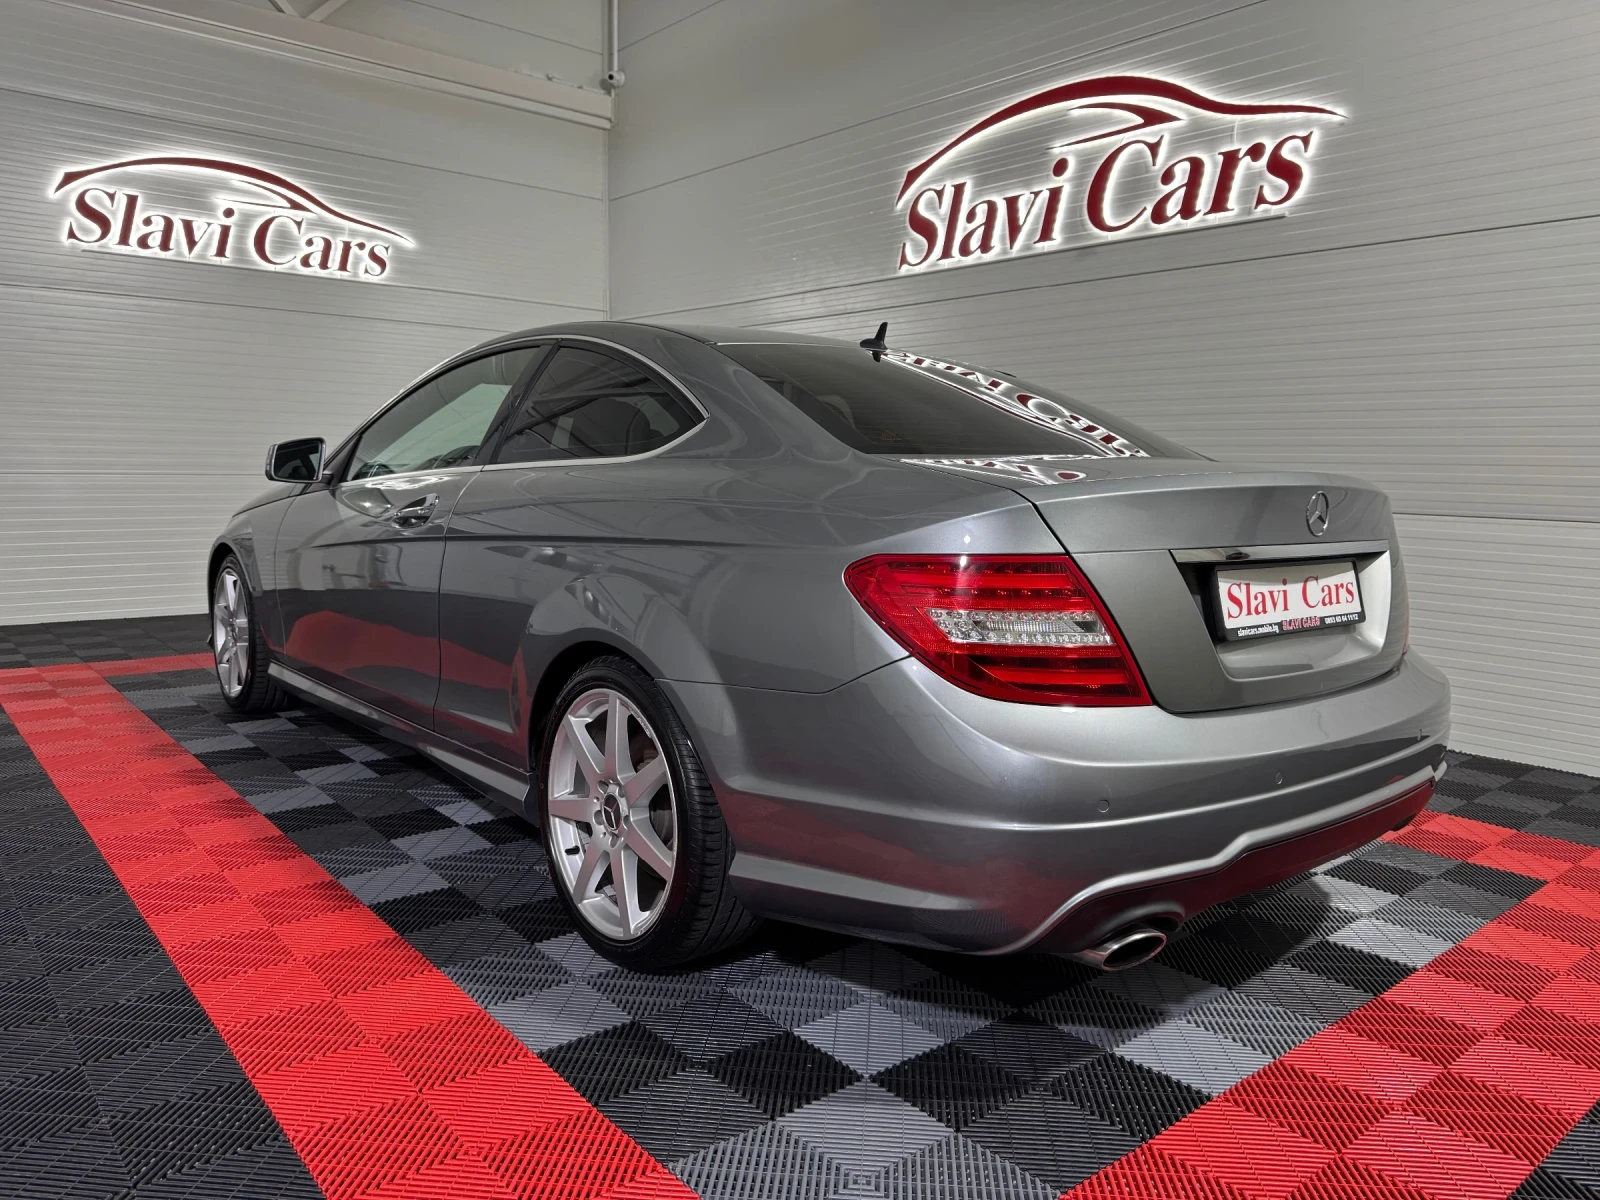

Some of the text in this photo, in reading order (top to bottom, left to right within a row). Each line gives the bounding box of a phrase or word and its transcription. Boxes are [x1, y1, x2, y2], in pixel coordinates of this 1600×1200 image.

[898, 130, 1317, 271] Slavi Cars
[66, 186, 391, 278] Slavi Cars
[1227, 575, 1355, 620] Slavi Cars
[1237, 624, 1279, 637] slavicars.mobile.bg
[1282, 616, 1320, 631] SLAVI CARS
